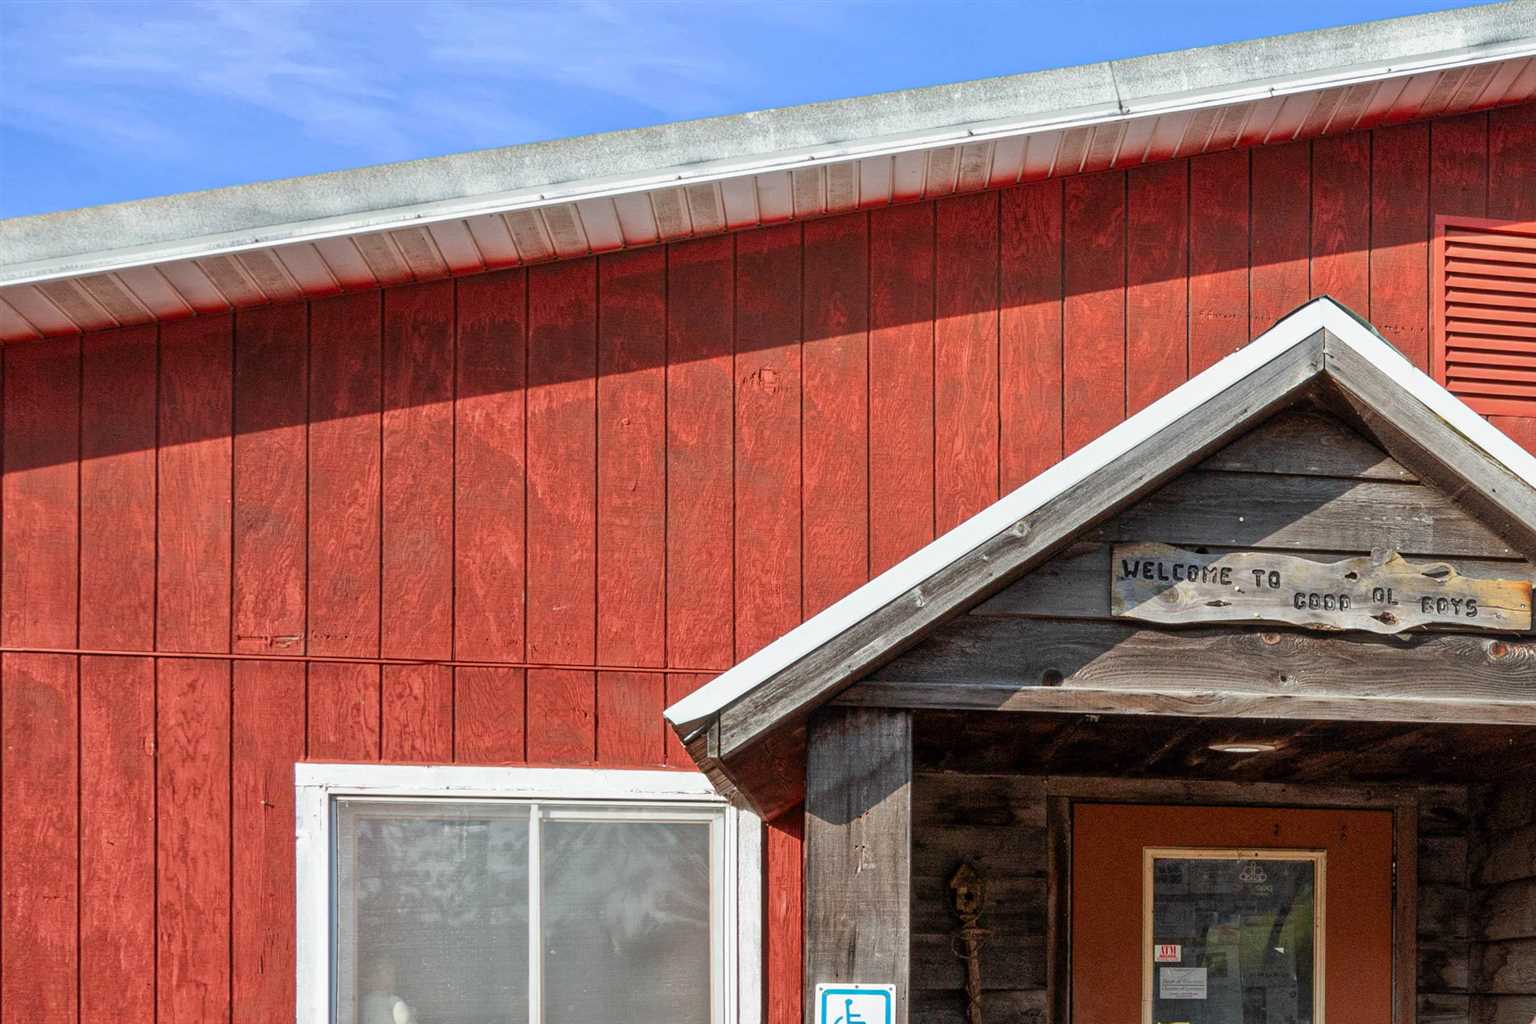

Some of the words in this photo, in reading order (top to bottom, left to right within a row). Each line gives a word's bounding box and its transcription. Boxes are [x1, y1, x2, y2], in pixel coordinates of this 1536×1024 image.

[1121, 559, 1233, 585] WELCOME
[1252, 569, 1281, 589] TO
[1294, 592, 1351, 612] GOOD
[1372, 587, 1398, 606] OL
[1421, 597, 1478, 617] BOYS
